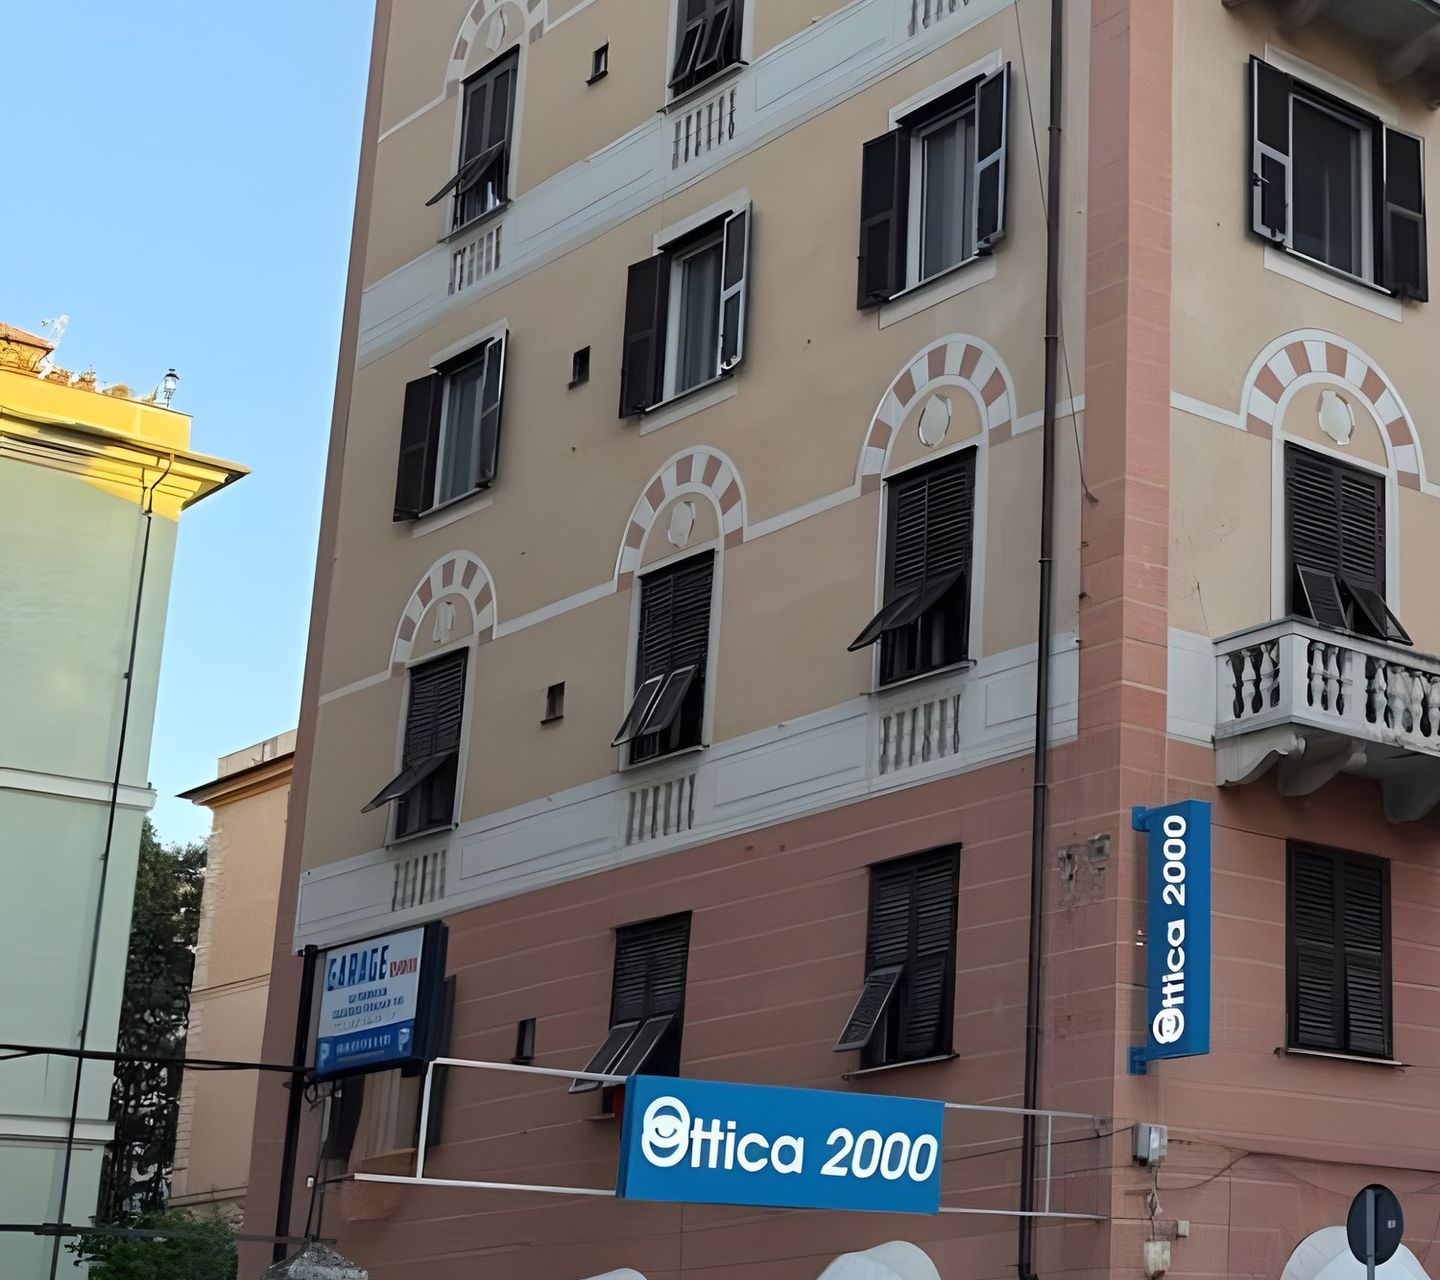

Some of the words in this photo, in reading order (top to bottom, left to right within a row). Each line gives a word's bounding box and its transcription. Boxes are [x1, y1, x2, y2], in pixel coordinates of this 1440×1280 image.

[1162, 815, 1187, 906] 2000
[327, 945, 389, 991] GARAGE
[1152, 918, 1185, 1045] Ottica
[641, 1095, 804, 1174] Ottica
[820, 1127, 938, 1182] 2000
